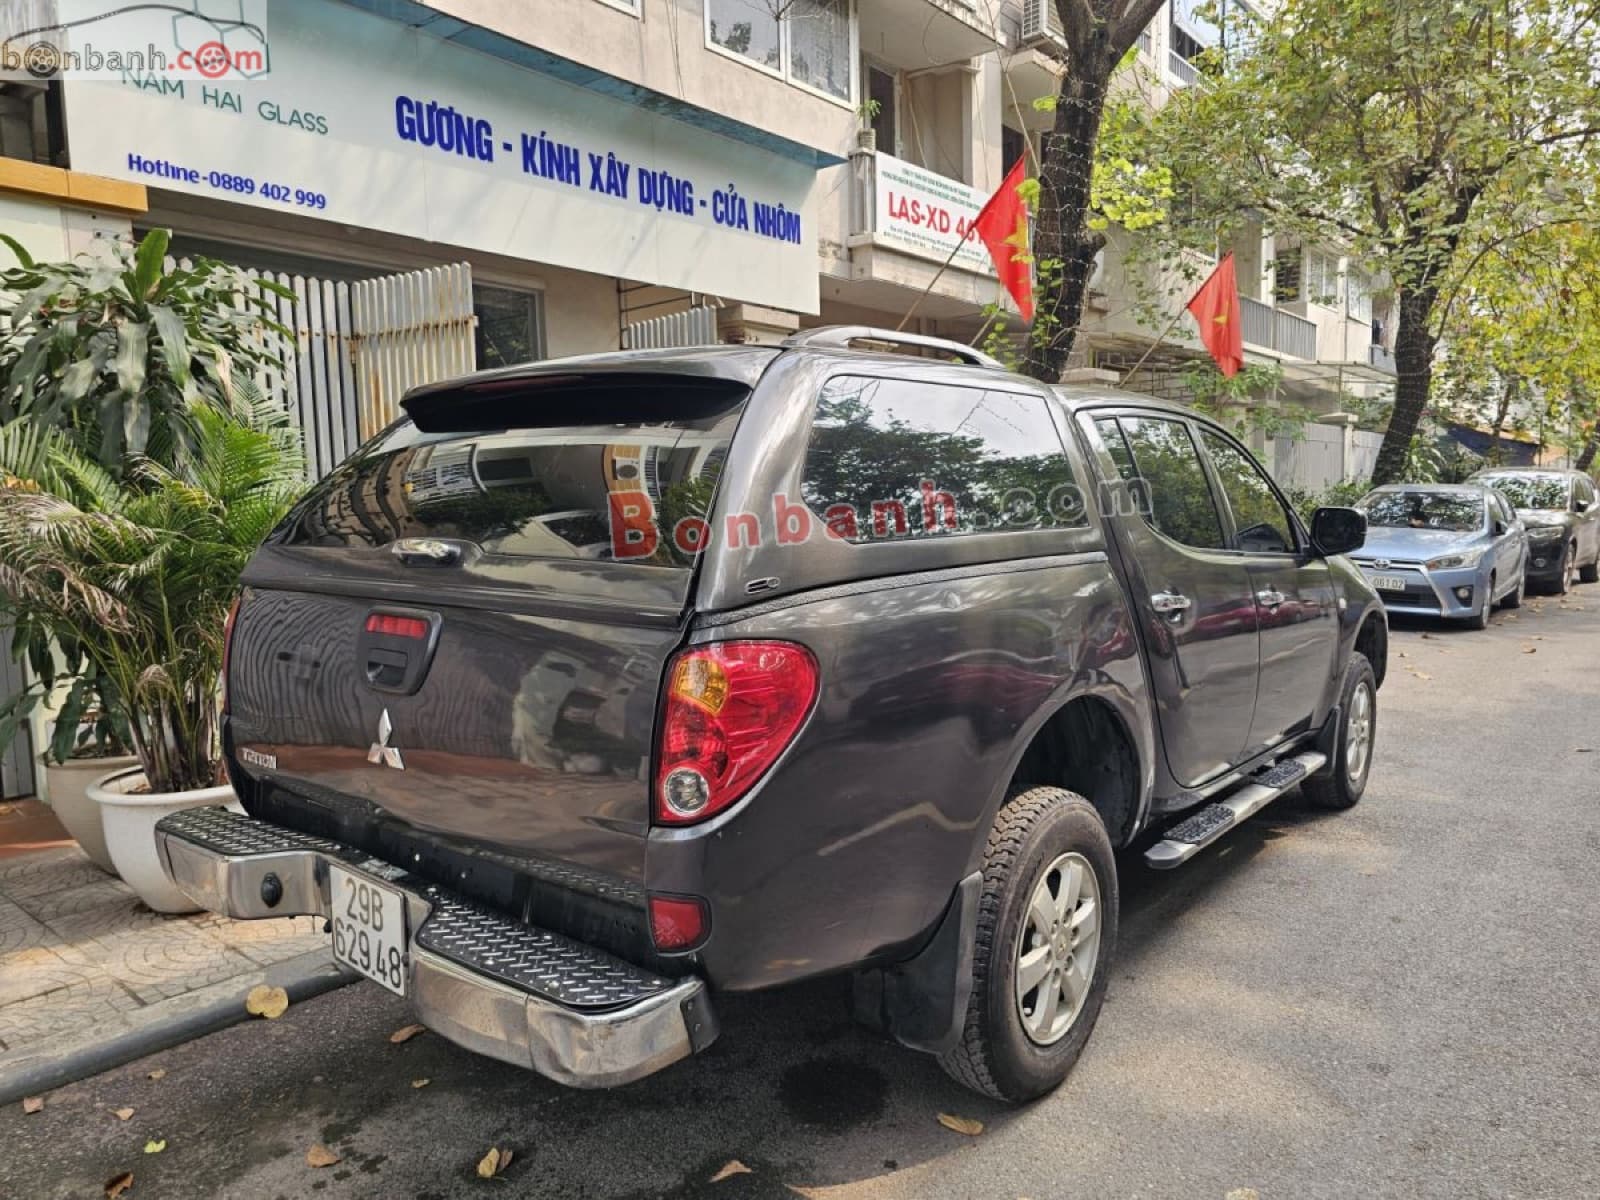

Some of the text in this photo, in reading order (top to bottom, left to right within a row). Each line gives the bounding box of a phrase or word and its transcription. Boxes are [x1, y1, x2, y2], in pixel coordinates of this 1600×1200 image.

[121, 69, 328, 135] NAM HAI GLASS
[259, 182, 291, 203] 402
[295, 189, 327, 210] 999
[396, 95, 493, 162] GƯƠNG
[521, 130, 580, 186] KÍNH
[589, 152, 630, 200] XÂY
[639, 167, 694, 216] DỰNG
[713, 183, 749, 231] CỬA
[754, 201, 801, 245] NHÔM
[888, 191, 950, 233] LAS-XD
[345, 877, 384, 933] 29B
[334, 916, 402, 989] 629.48
